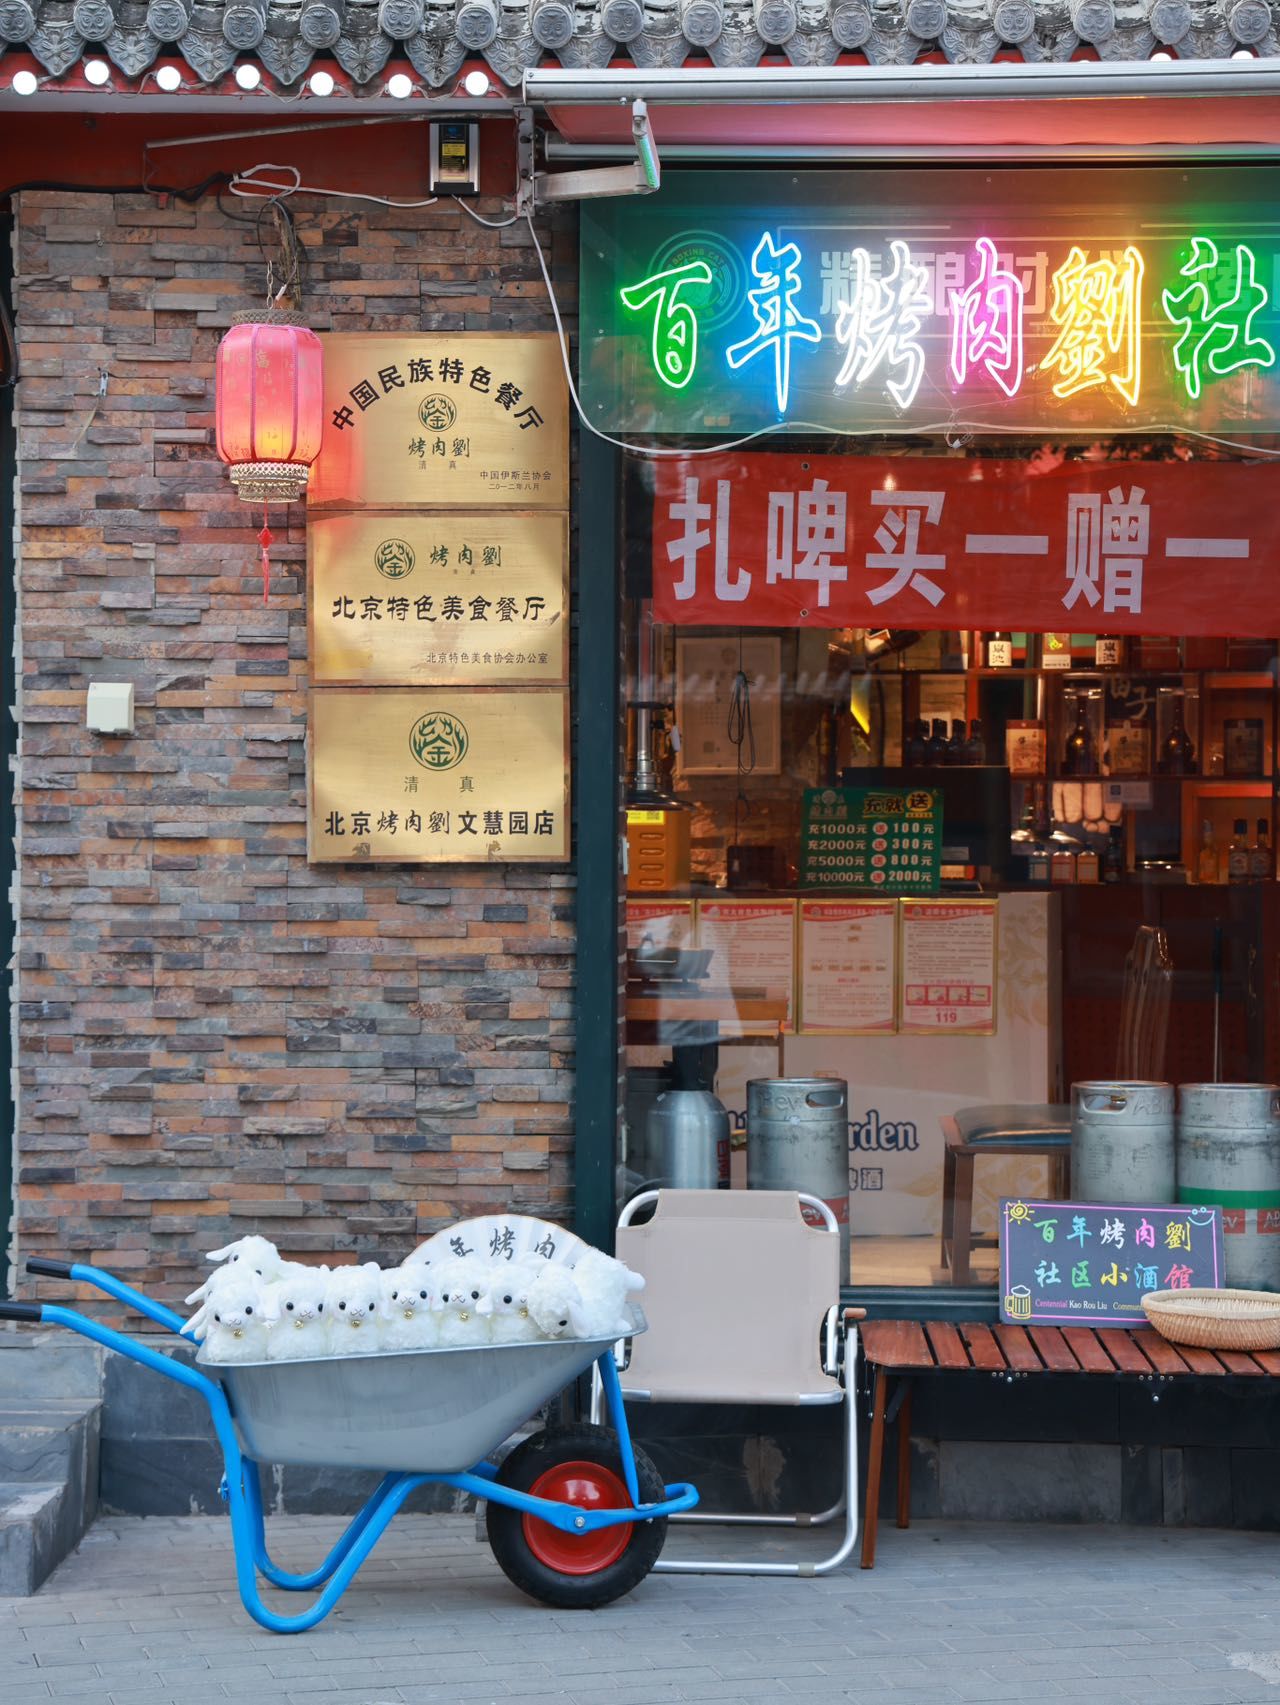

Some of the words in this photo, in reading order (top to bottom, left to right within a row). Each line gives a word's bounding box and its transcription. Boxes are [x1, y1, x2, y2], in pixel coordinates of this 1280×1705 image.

[331, 357, 545, 431] 中国民族特色餐厅
[408, 436, 470, 458] 烤肉劉
[479, 470, 552, 481] 中国伊斯兰协会
[429, 545, 502, 568] 烤肉劉
[665, 477, 1250, 614] 扎啤买一赠一
[332, 594, 546, 622] 北京特色美食餐厅
[427, 652, 549, 664] 北京特色美食协会办公室
[404, 775, 475, 793] 清真
[324, 810, 554, 836] 北京烤肉劉文慧园店
[889, 871, 932, 882] 2000元
[936, 1012, 957, 1023] 119
[1033, 1215, 1192, 1252] 百年烤肉劉
[1034, 1260, 1194, 1290] 社区小酒馆
[1069, 1300, 1082, 1309] Kao
[1083, 1301, 1096, 1309] Rou
